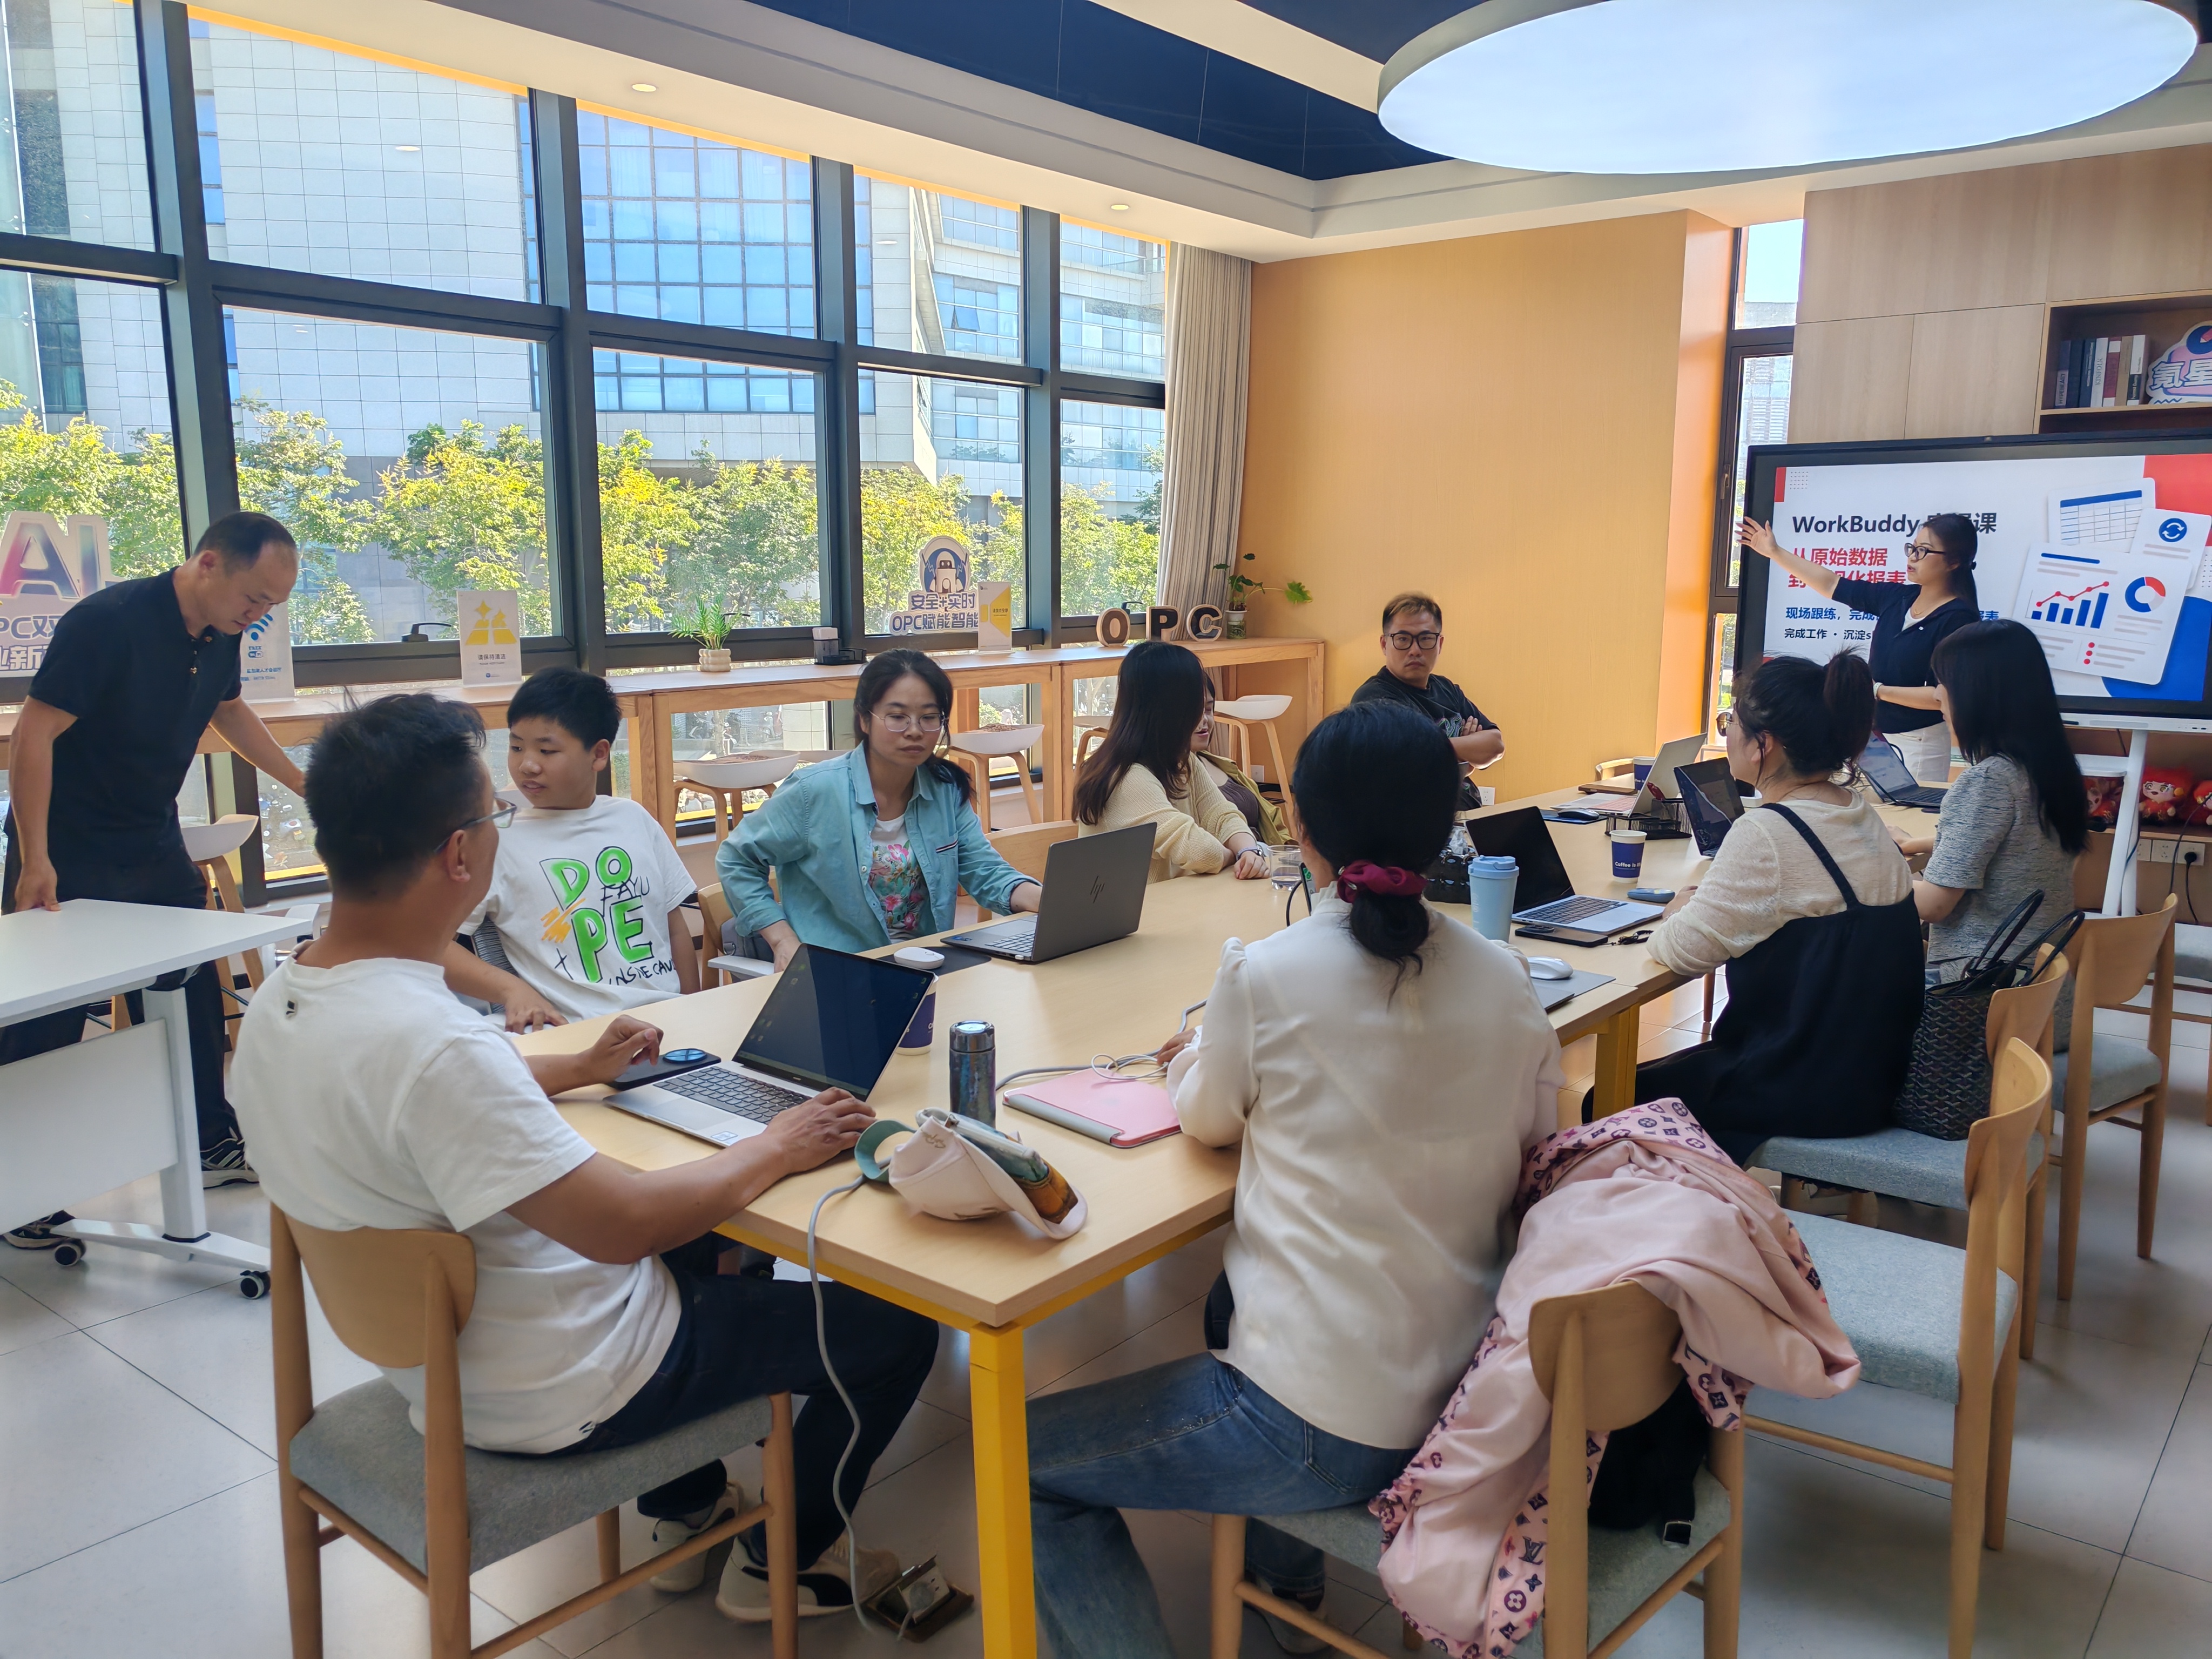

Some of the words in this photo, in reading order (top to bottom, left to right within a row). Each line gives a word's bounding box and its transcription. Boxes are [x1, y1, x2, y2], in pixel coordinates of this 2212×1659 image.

[2095, 358, 2103, 385] KINFOLK
[1792, 514, 1921, 537] WorkBuddy
[0, 522, 100, 598] AI
[911, 593, 975, 610] 安全+实时
[892, 612, 979, 631] OPC赋能智能
[1785, 607, 1880, 621] 现场跟练，完成
[1096, 604, 1223, 647] OPC
[1784, 628, 1827, 639] 完成工作
[1843, 629, 1872, 640] 沉淀s
